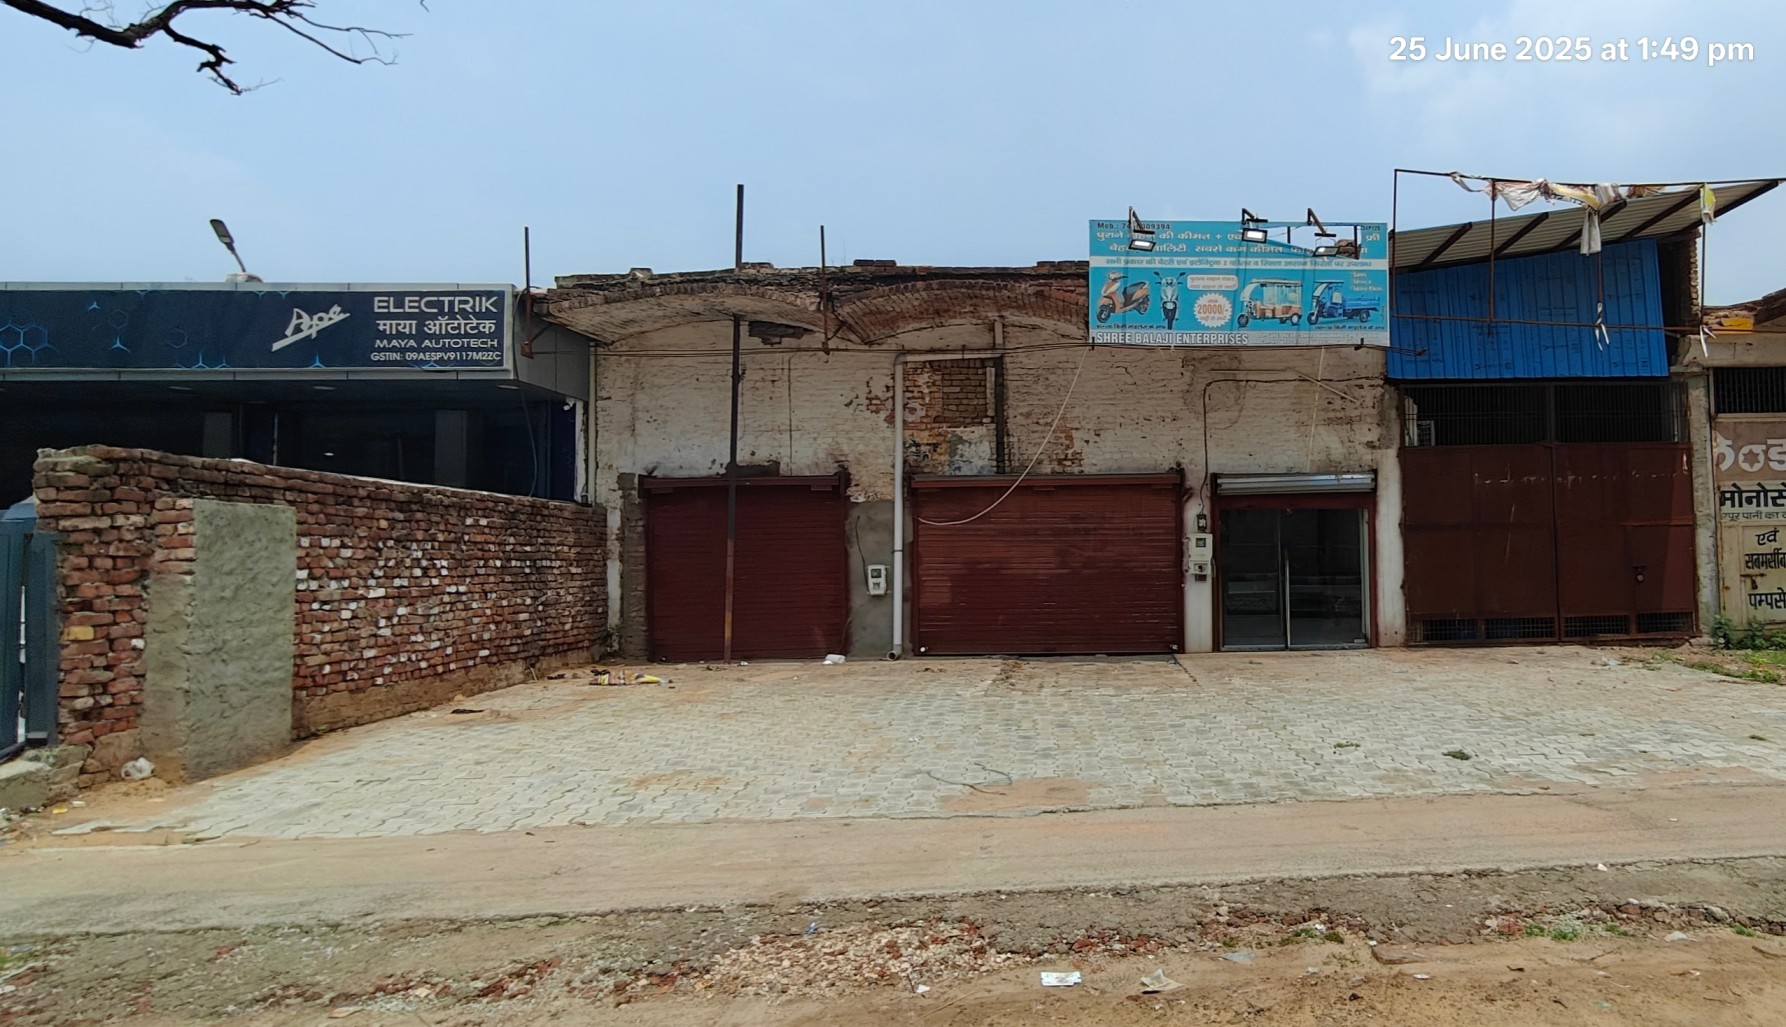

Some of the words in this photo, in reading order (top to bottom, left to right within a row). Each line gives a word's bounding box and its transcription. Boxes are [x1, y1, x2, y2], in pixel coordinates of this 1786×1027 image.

[373, 296, 499, 313] ELECTRIK
[376, 319, 417, 335] माया
[423, 314, 496, 335] ऑटोटेक
[375, 338, 418, 348] MAYA
[421, 338, 498, 348] AUTOTECH
[1096, 332, 1132, 344] SHREE
[1135, 332, 1173, 344] BALAJI
[1176, 333, 1248, 345] ENTERPRISES
[370, 351, 404, 361] GSTIN:
[1755, 528, 1780, 546] एवं
